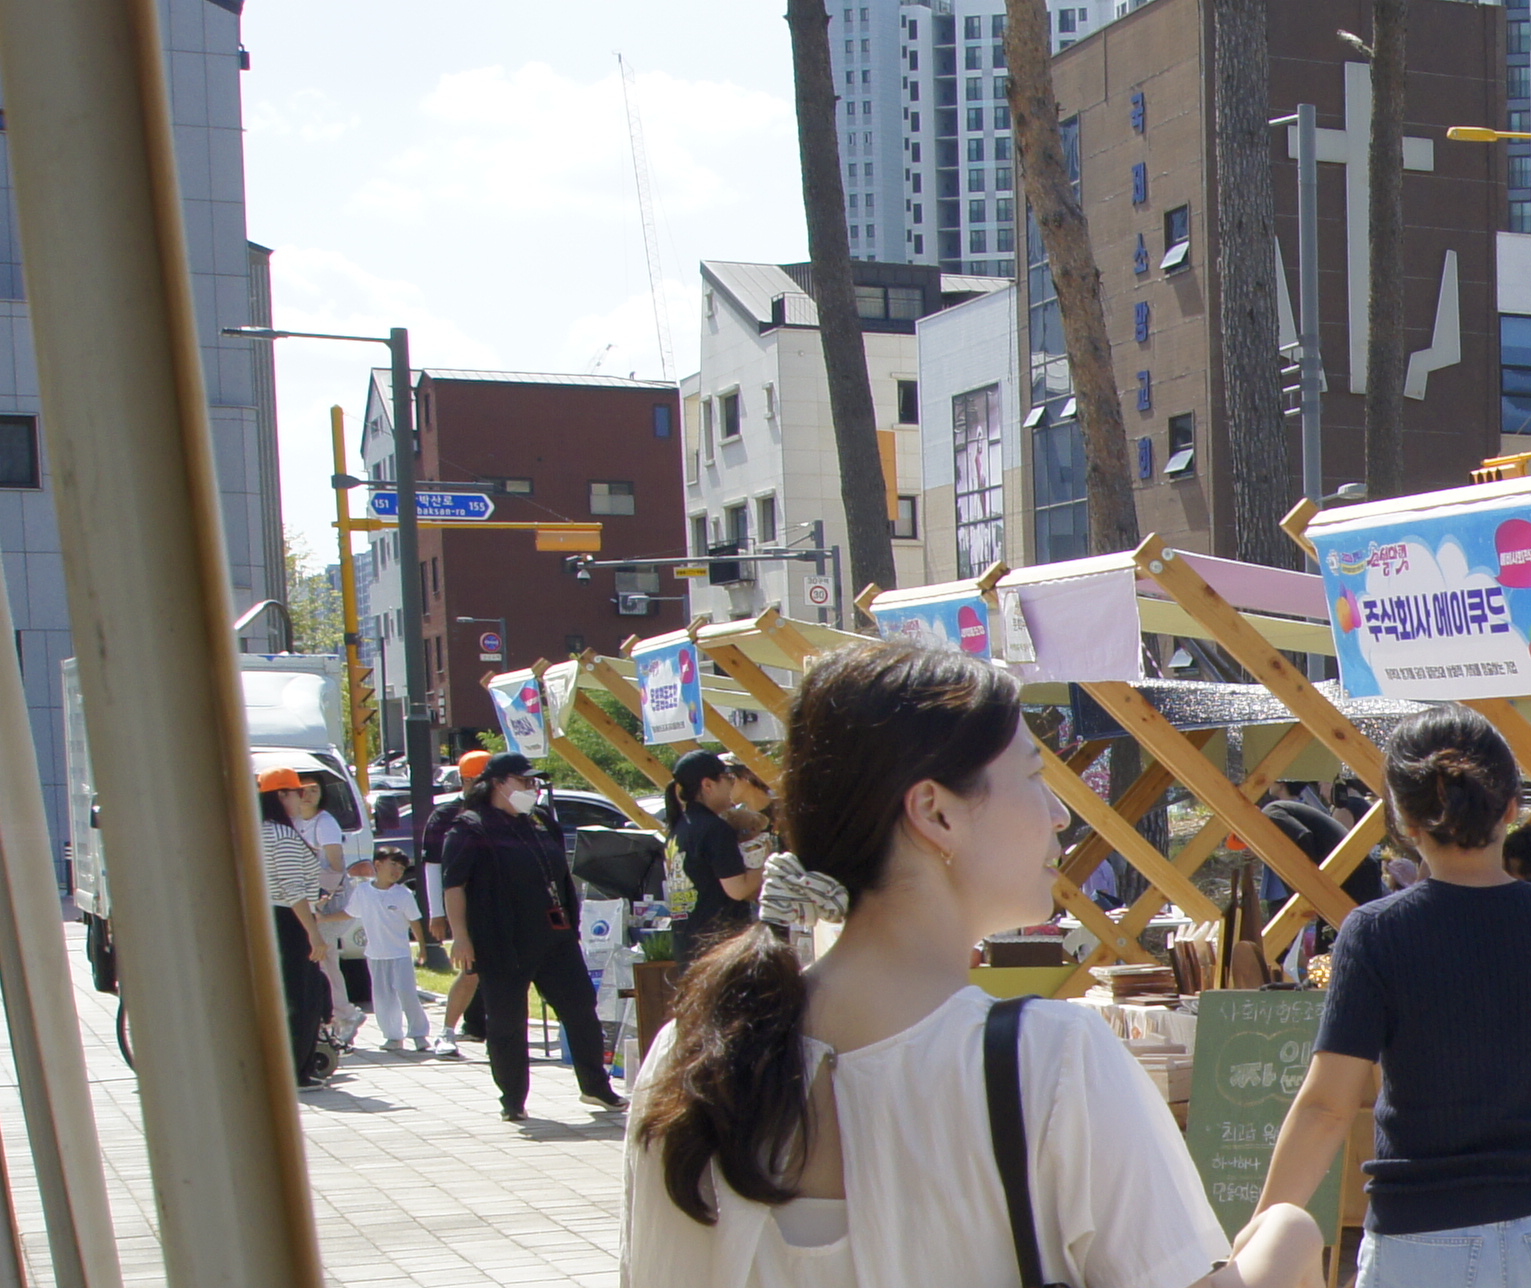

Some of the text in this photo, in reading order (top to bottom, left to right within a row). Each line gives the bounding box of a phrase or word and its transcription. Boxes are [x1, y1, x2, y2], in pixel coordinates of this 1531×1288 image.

[1131, 91, 1152, 479] 국제소망교회
[374, 499, 389, 508] 151
[415, 495, 454, 507] 박산로
[469, 502, 486, 511] 155
[813, 590, 825, 599] 30
[1363, 587, 1510, 642] 주식회사 에이쿠드
[1213, 1181, 1262, 1203] 만들었습
